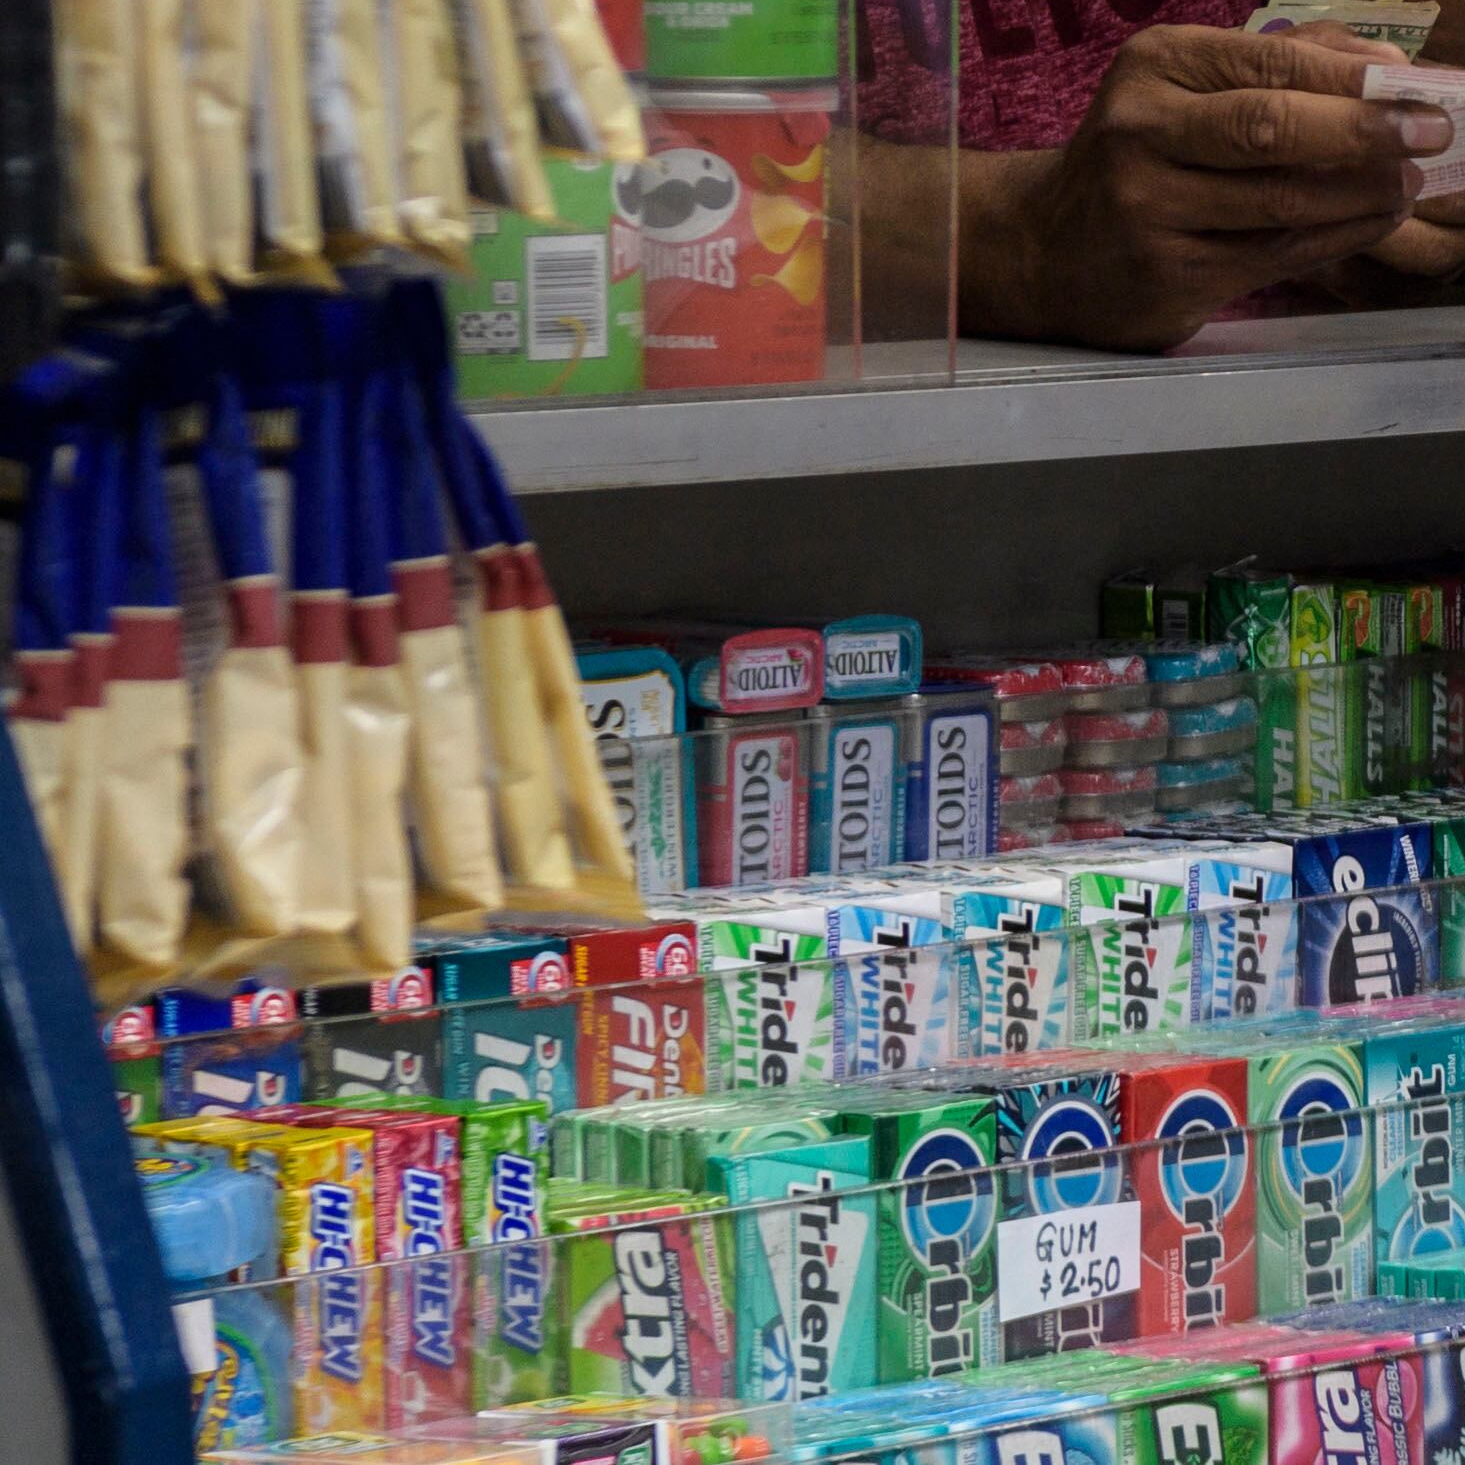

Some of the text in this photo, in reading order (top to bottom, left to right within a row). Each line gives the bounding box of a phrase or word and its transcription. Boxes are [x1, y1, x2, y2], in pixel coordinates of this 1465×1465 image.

[642, 235, 737, 289] RINGLES
[1446, 1052, 1458, 1088] GUM
[403, 1166, 456, 1369] HI-CHEW
[492, 1152, 544, 1355] HI-CHEW
[1036, 1219, 1098, 1263] GUM
[310, 1181, 364, 1385] HI-CHEW
[1359, 1388, 1373, 1434] FLAVOR
